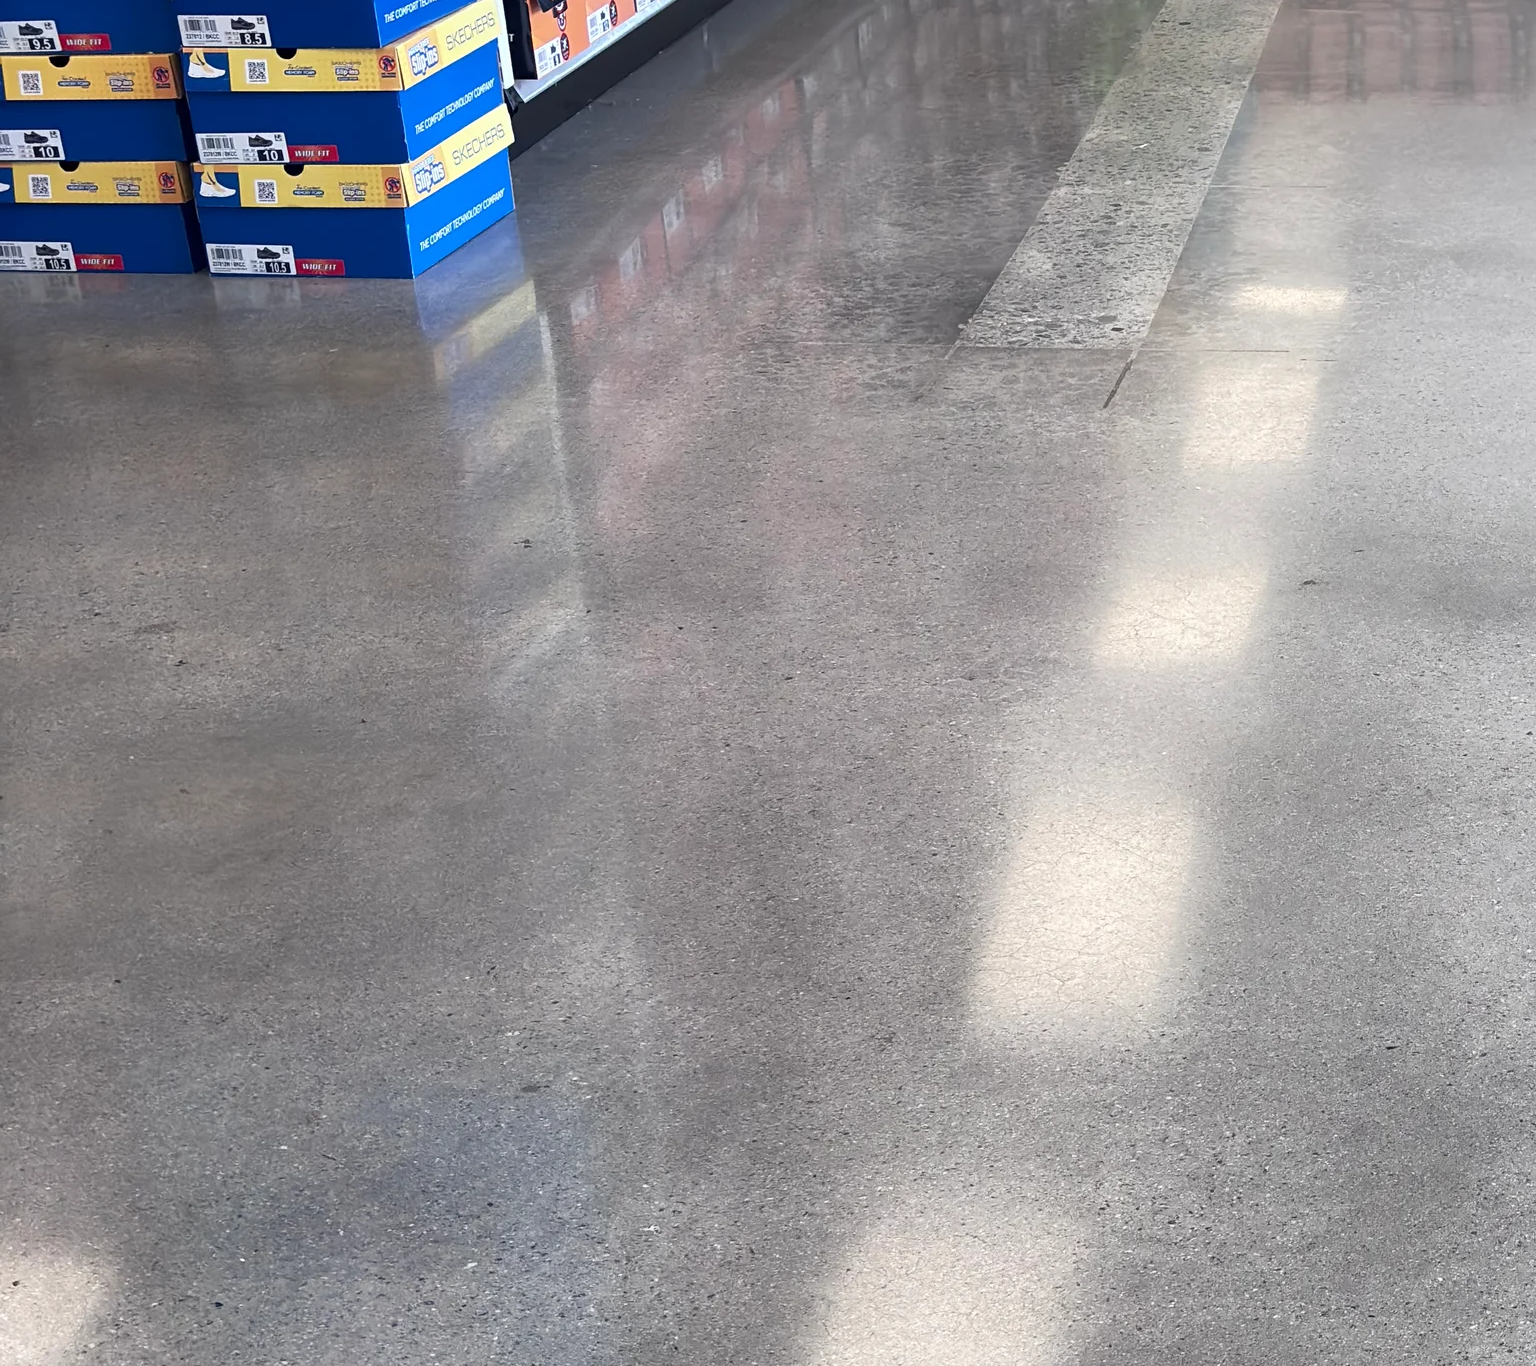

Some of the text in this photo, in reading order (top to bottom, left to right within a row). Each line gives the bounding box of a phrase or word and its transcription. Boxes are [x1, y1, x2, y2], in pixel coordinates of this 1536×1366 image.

[383, 12, 395, 24] THE
[395, 1, 419, 19] COMFORT
[445, 11, 496, 51] SKECHERS
[31, 38, 52, 50] 9.5
[65, 38, 102, 47] WIDE FIT
[243, 33, 263, 45] 8.5
[409, 45, 439, 76] Slip-ins
[414, 77, 495, 135] THE COMFORT TECHNOLOGY COMPANY
[451, 123, 506, 166] SKECHERS
[39, 146, 55, 159] 10
[263, 150, 279, 162] 10
[294, 149, 330, 157] WIDE FIT
[413, 162, 446, 194] Slip-ins
[419, 187, 505, 252] THE COMFORT TECHNOLOGY COMPANY
[48, 258, 67, 270] 10.5
[80, 257, 115, 266] WIDE FIT
[302, 263, 337, 271] WIDE FIT
[268, 262, 288, 274] 10.5
